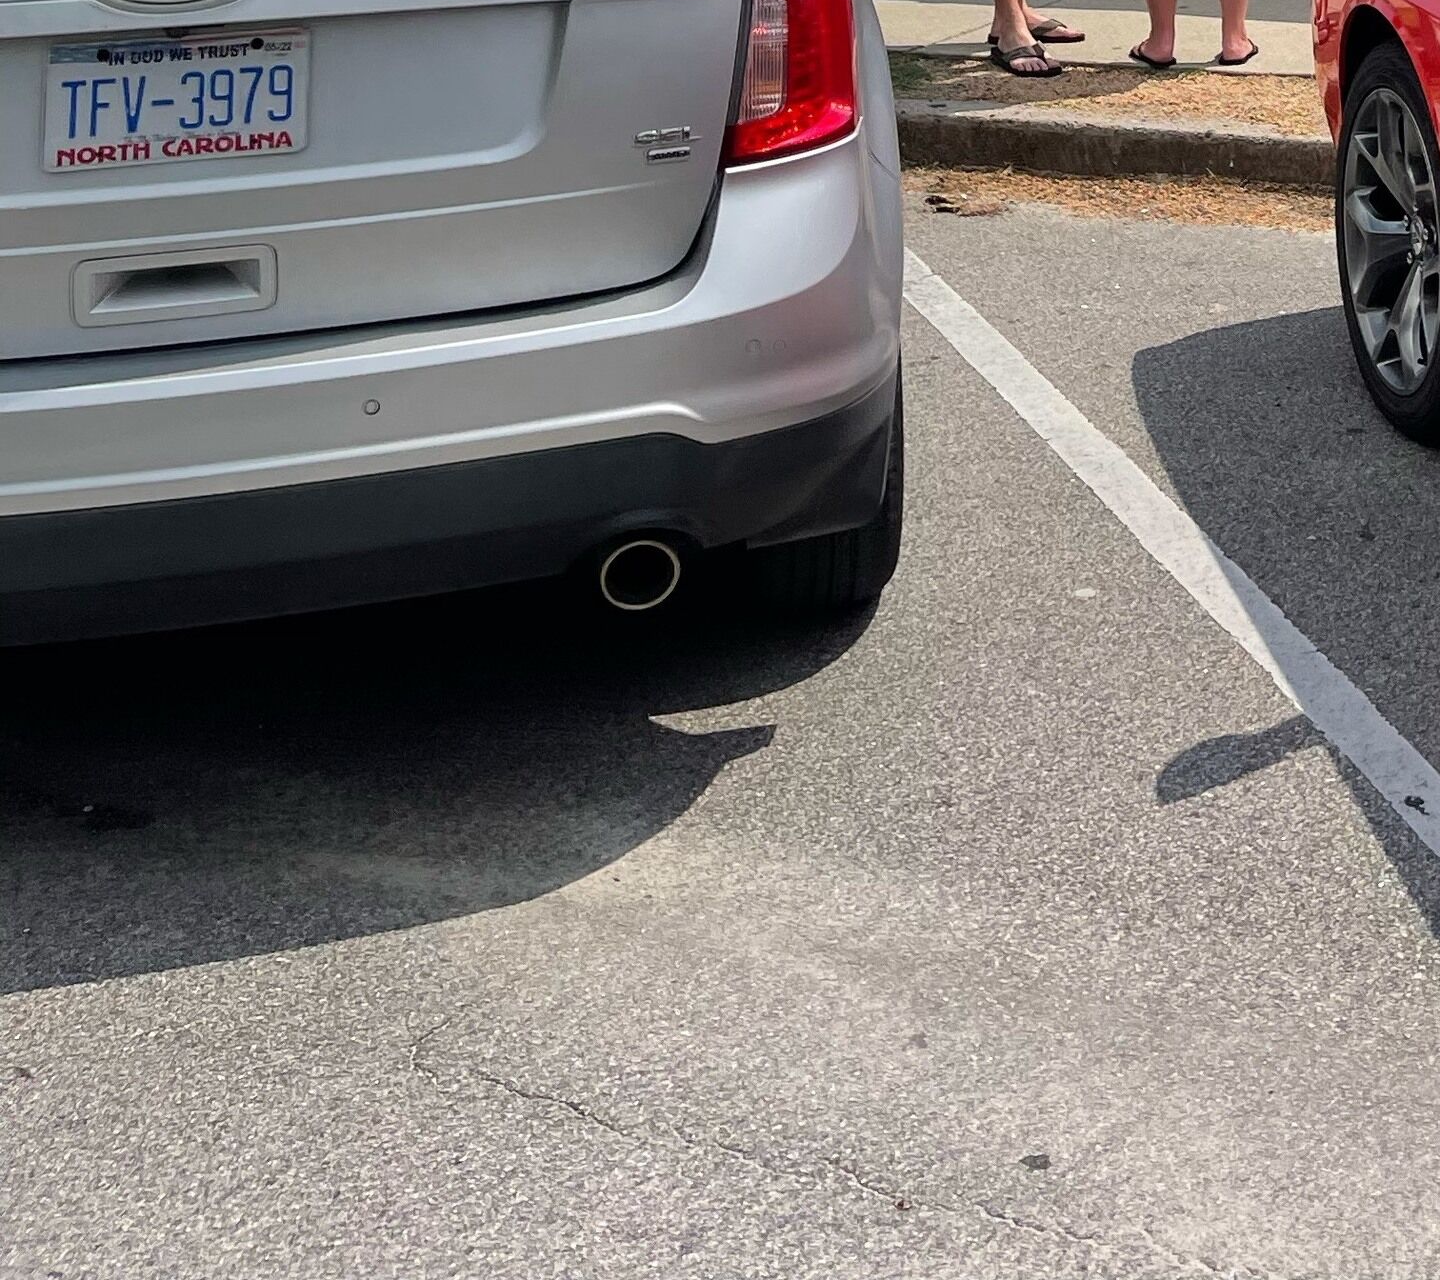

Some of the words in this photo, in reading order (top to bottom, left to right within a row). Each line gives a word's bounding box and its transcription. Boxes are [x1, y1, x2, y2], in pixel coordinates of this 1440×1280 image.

[108, 51, 125, 66] IN
[169, 47, 193, 61] WE
[197, 43, 250, 60] TRUST
[61, 64, 294, 139] TFV-3979
[56, 141, 151, 168] NORTH
[162, 131, 293, 157] CAROLINA
